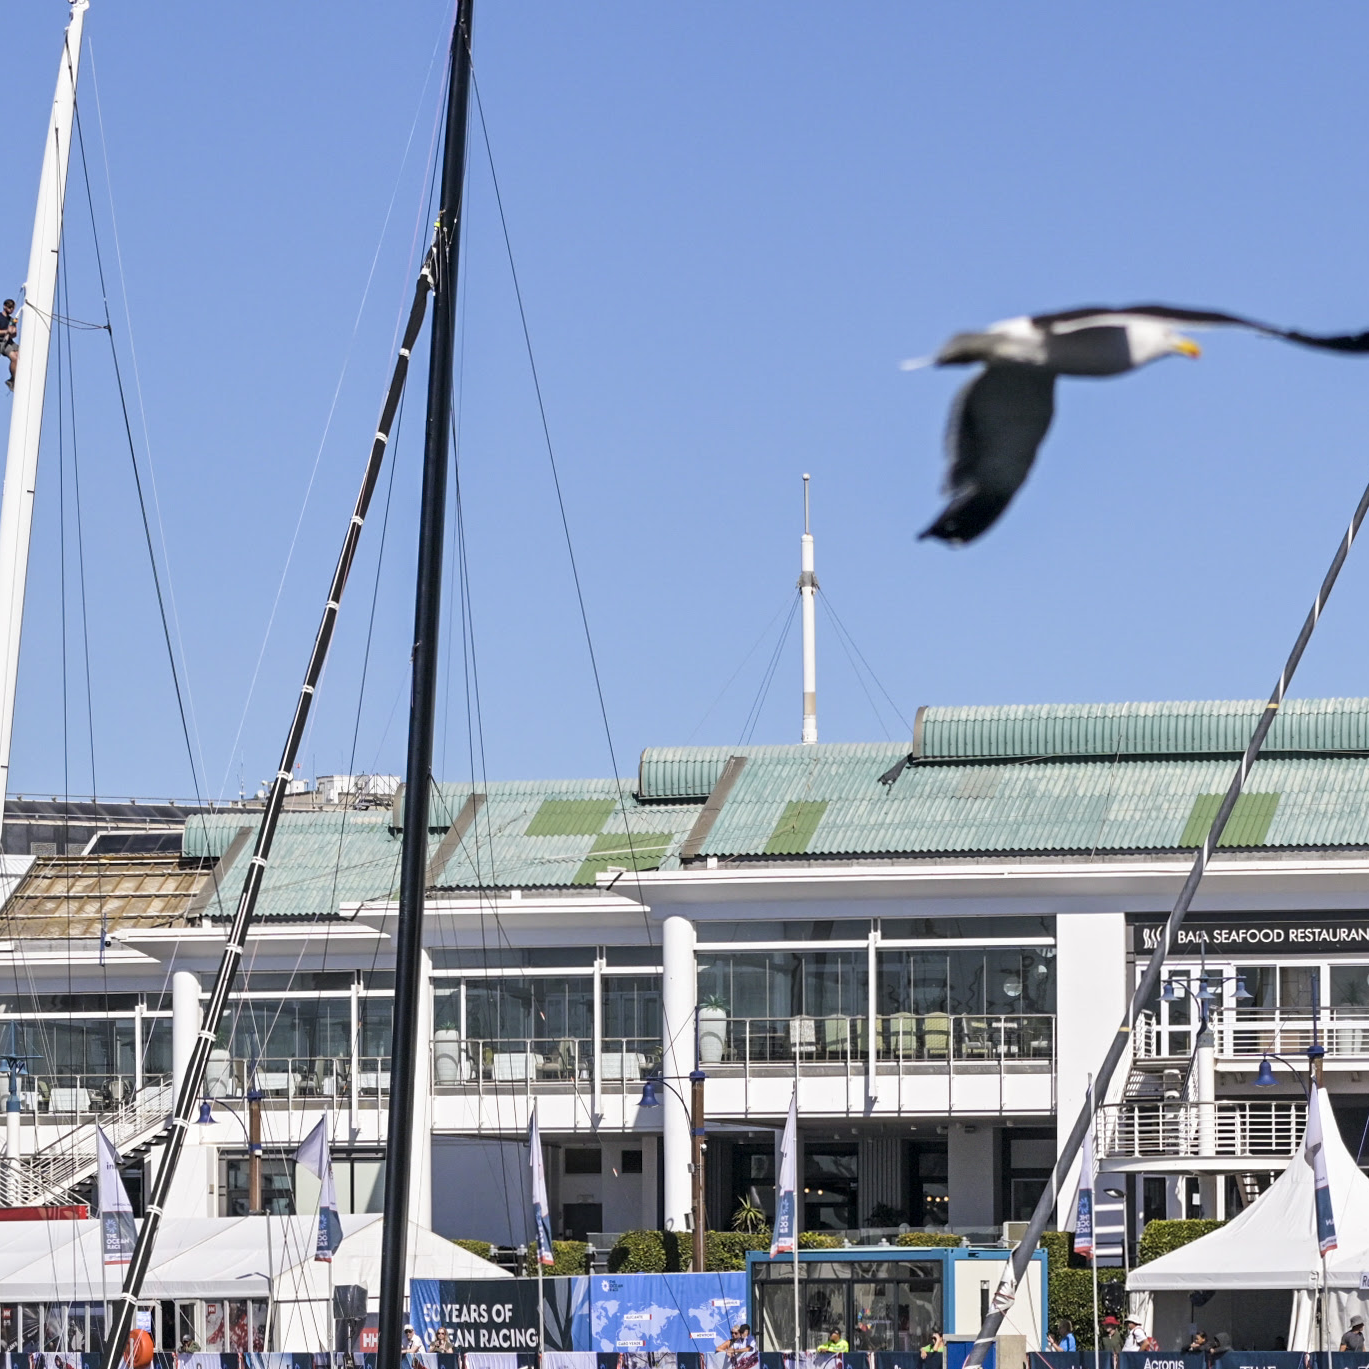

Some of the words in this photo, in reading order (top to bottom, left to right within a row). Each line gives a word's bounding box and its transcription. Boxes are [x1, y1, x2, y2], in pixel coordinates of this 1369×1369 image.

[1213, 928, 1285, 944] SEAFOOD
[424, 1304, 441, 1323] 50
[442, 1304, 488, 1323] YEARS
[491, 1303, 513, 1323] OF
[363, 1334, 379, 1348] HH
[480, 1328, 539, 1349] RACING
